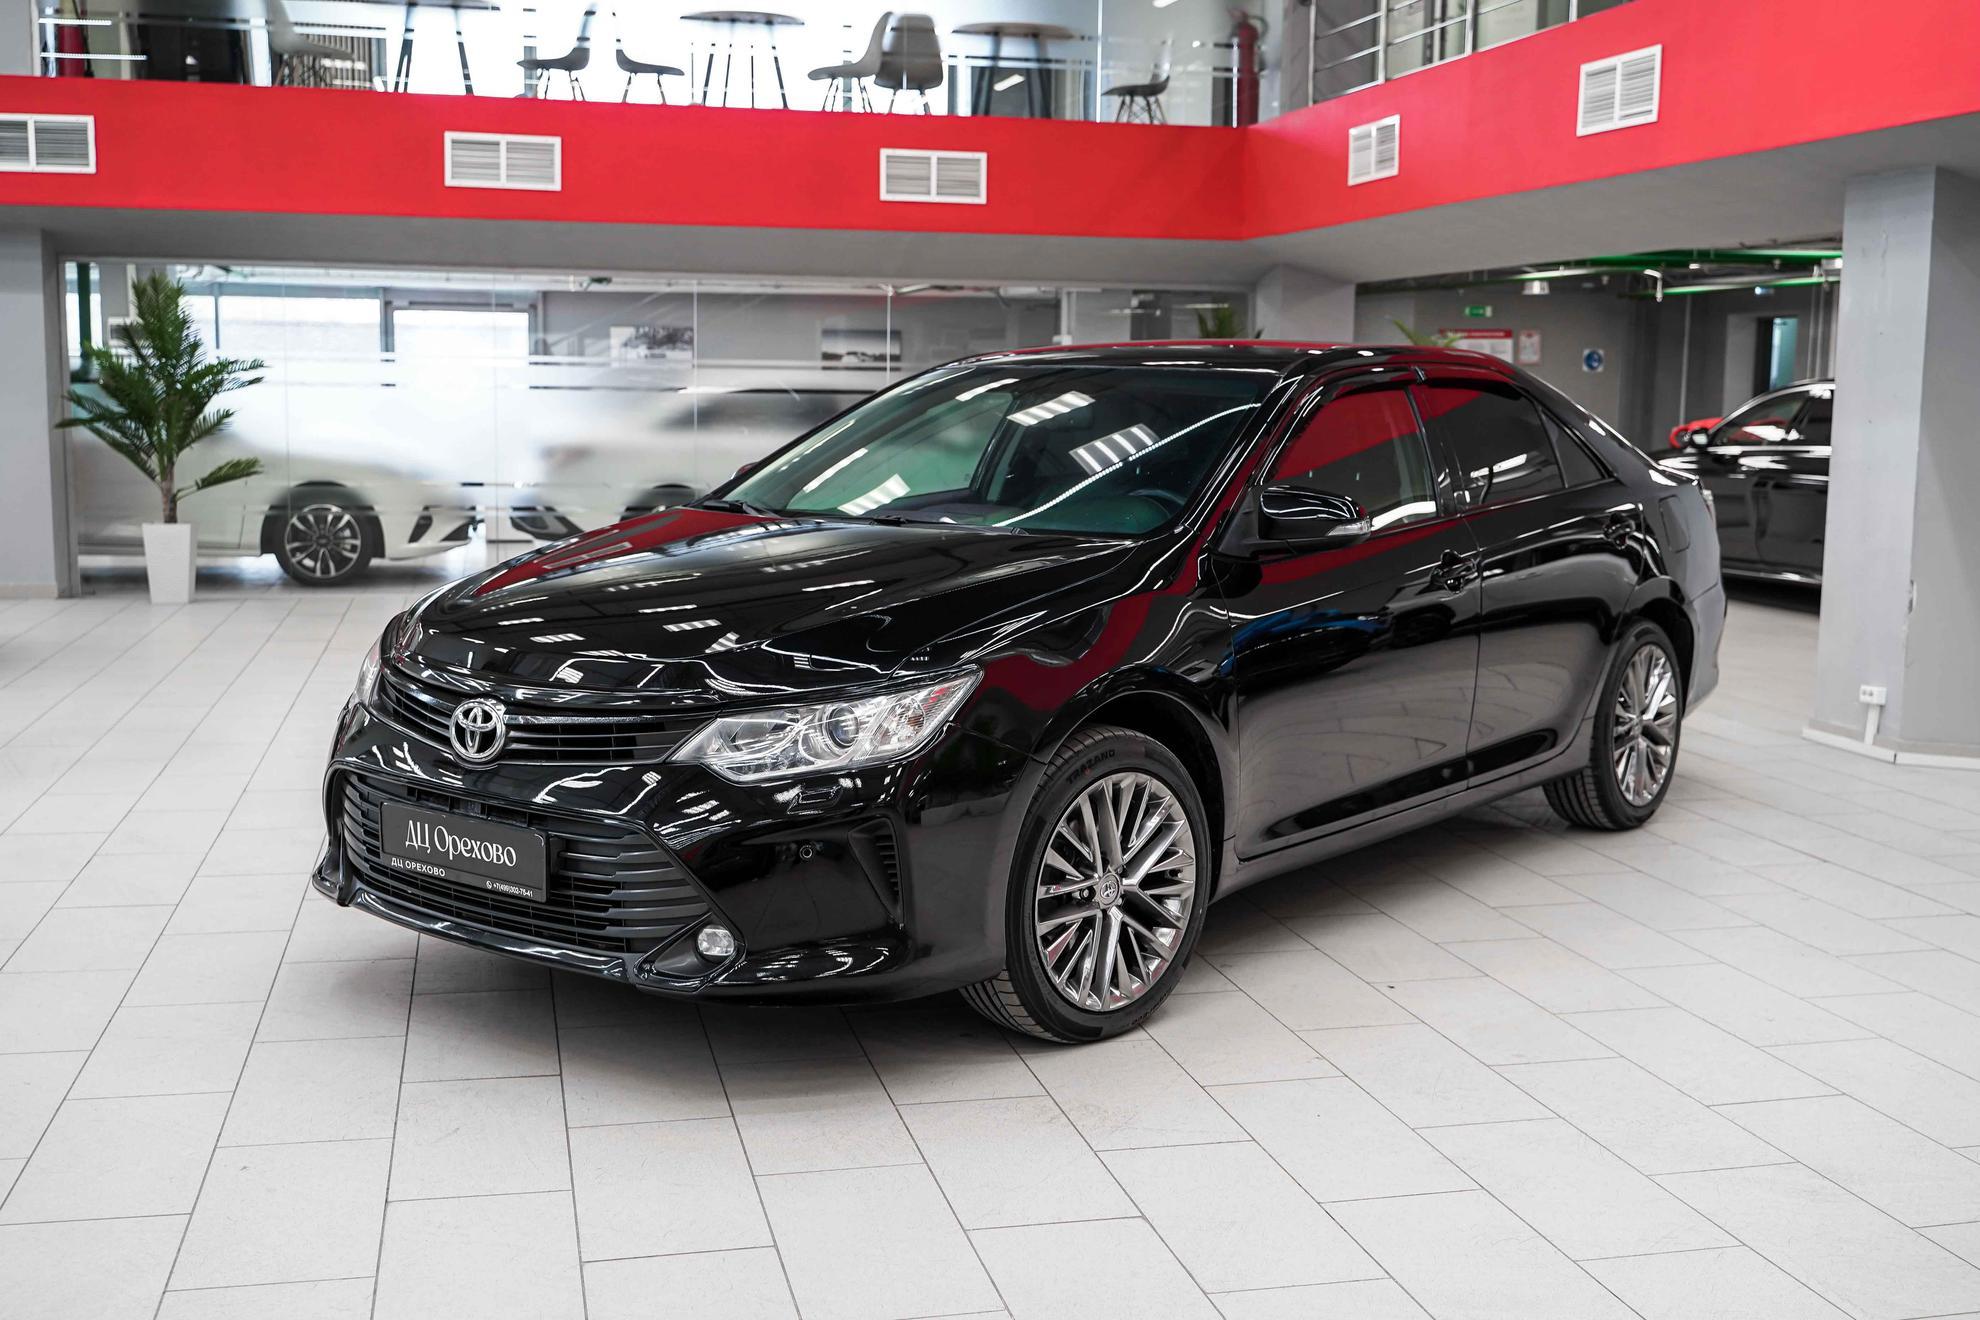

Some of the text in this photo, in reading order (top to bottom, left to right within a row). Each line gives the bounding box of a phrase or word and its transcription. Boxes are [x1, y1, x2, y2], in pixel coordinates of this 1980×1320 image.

[405, 819, 517, 868] ДЦ Орехово
[391, 857, 446, 877] ДЦ ОРЕХОВО
